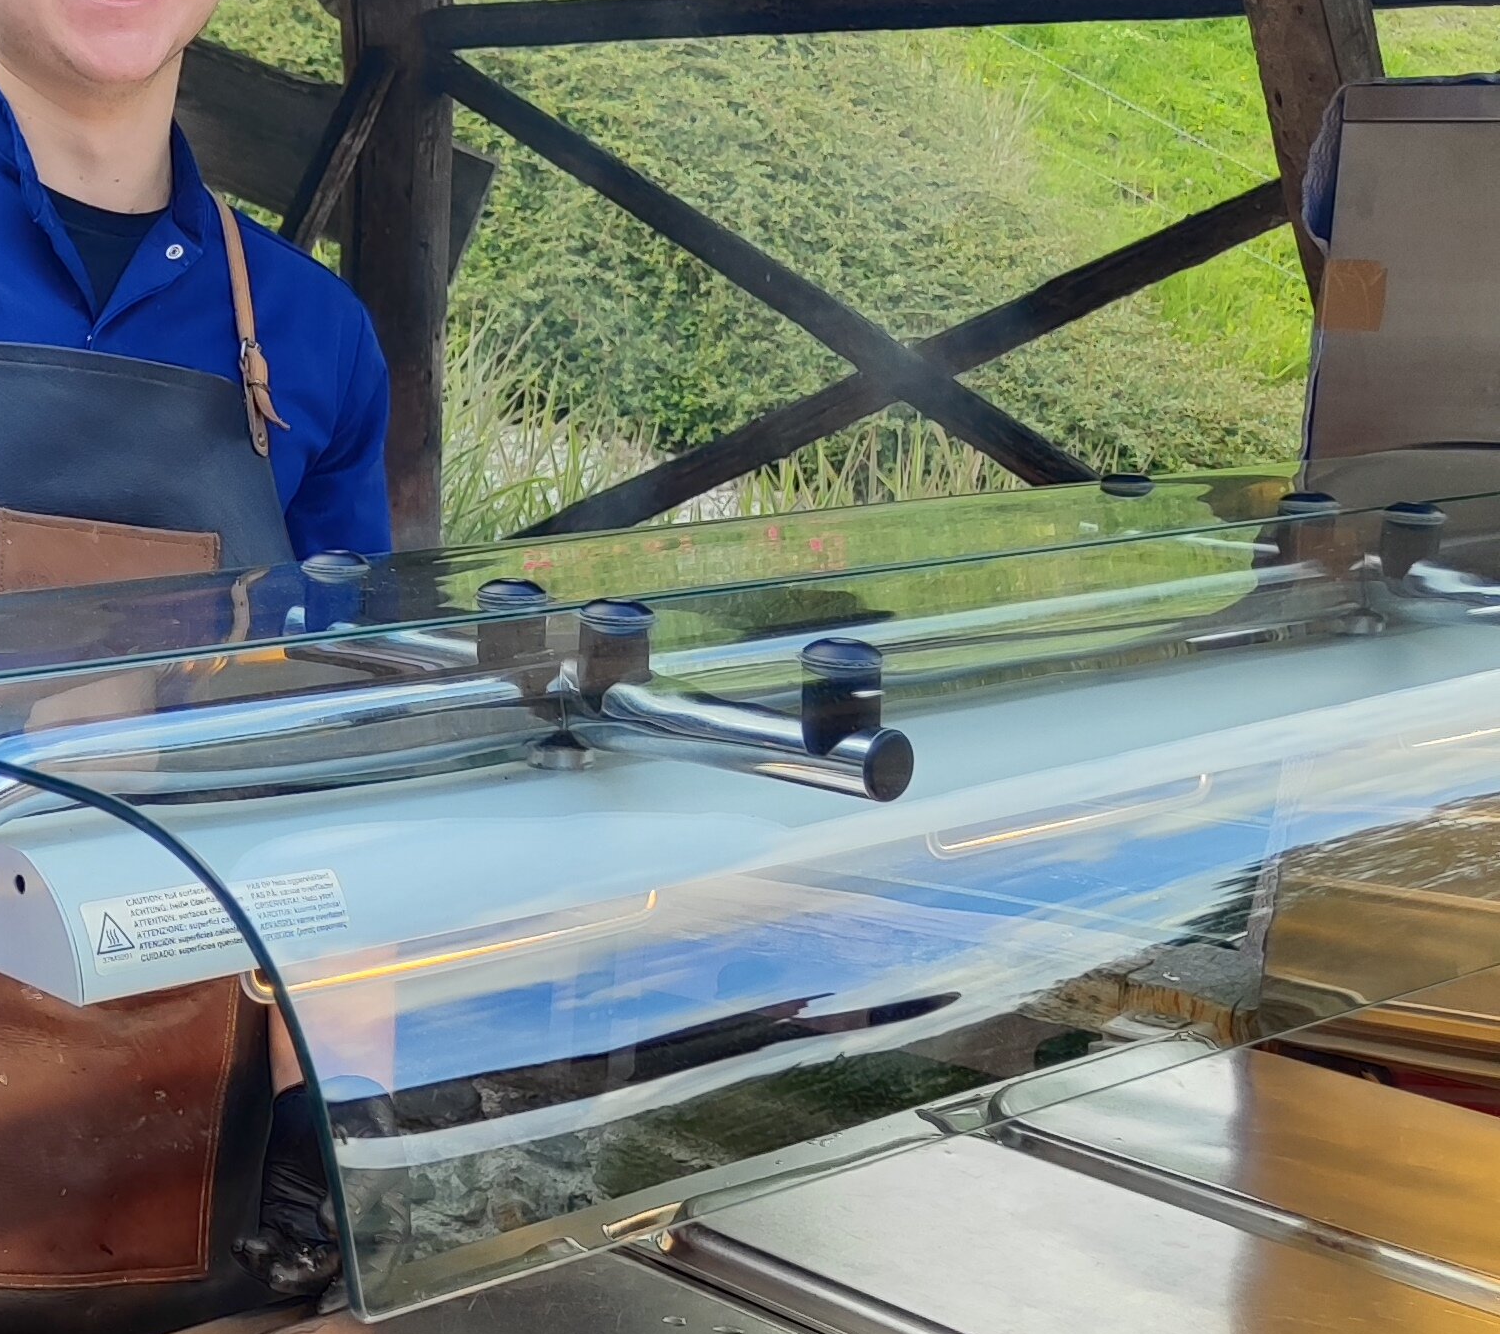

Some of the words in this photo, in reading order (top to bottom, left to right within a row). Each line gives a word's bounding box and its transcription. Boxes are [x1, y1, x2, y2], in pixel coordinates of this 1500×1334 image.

[126, 895, 162, 906] CAUTION:
[130, 904, 167, 916] ACHTUNG:
[134, 915, 177, 927] ATTENTION:
[137, 924, 187, 938] ATTENZIONE:
[141, 949, 176, 962] CUIDADO:
